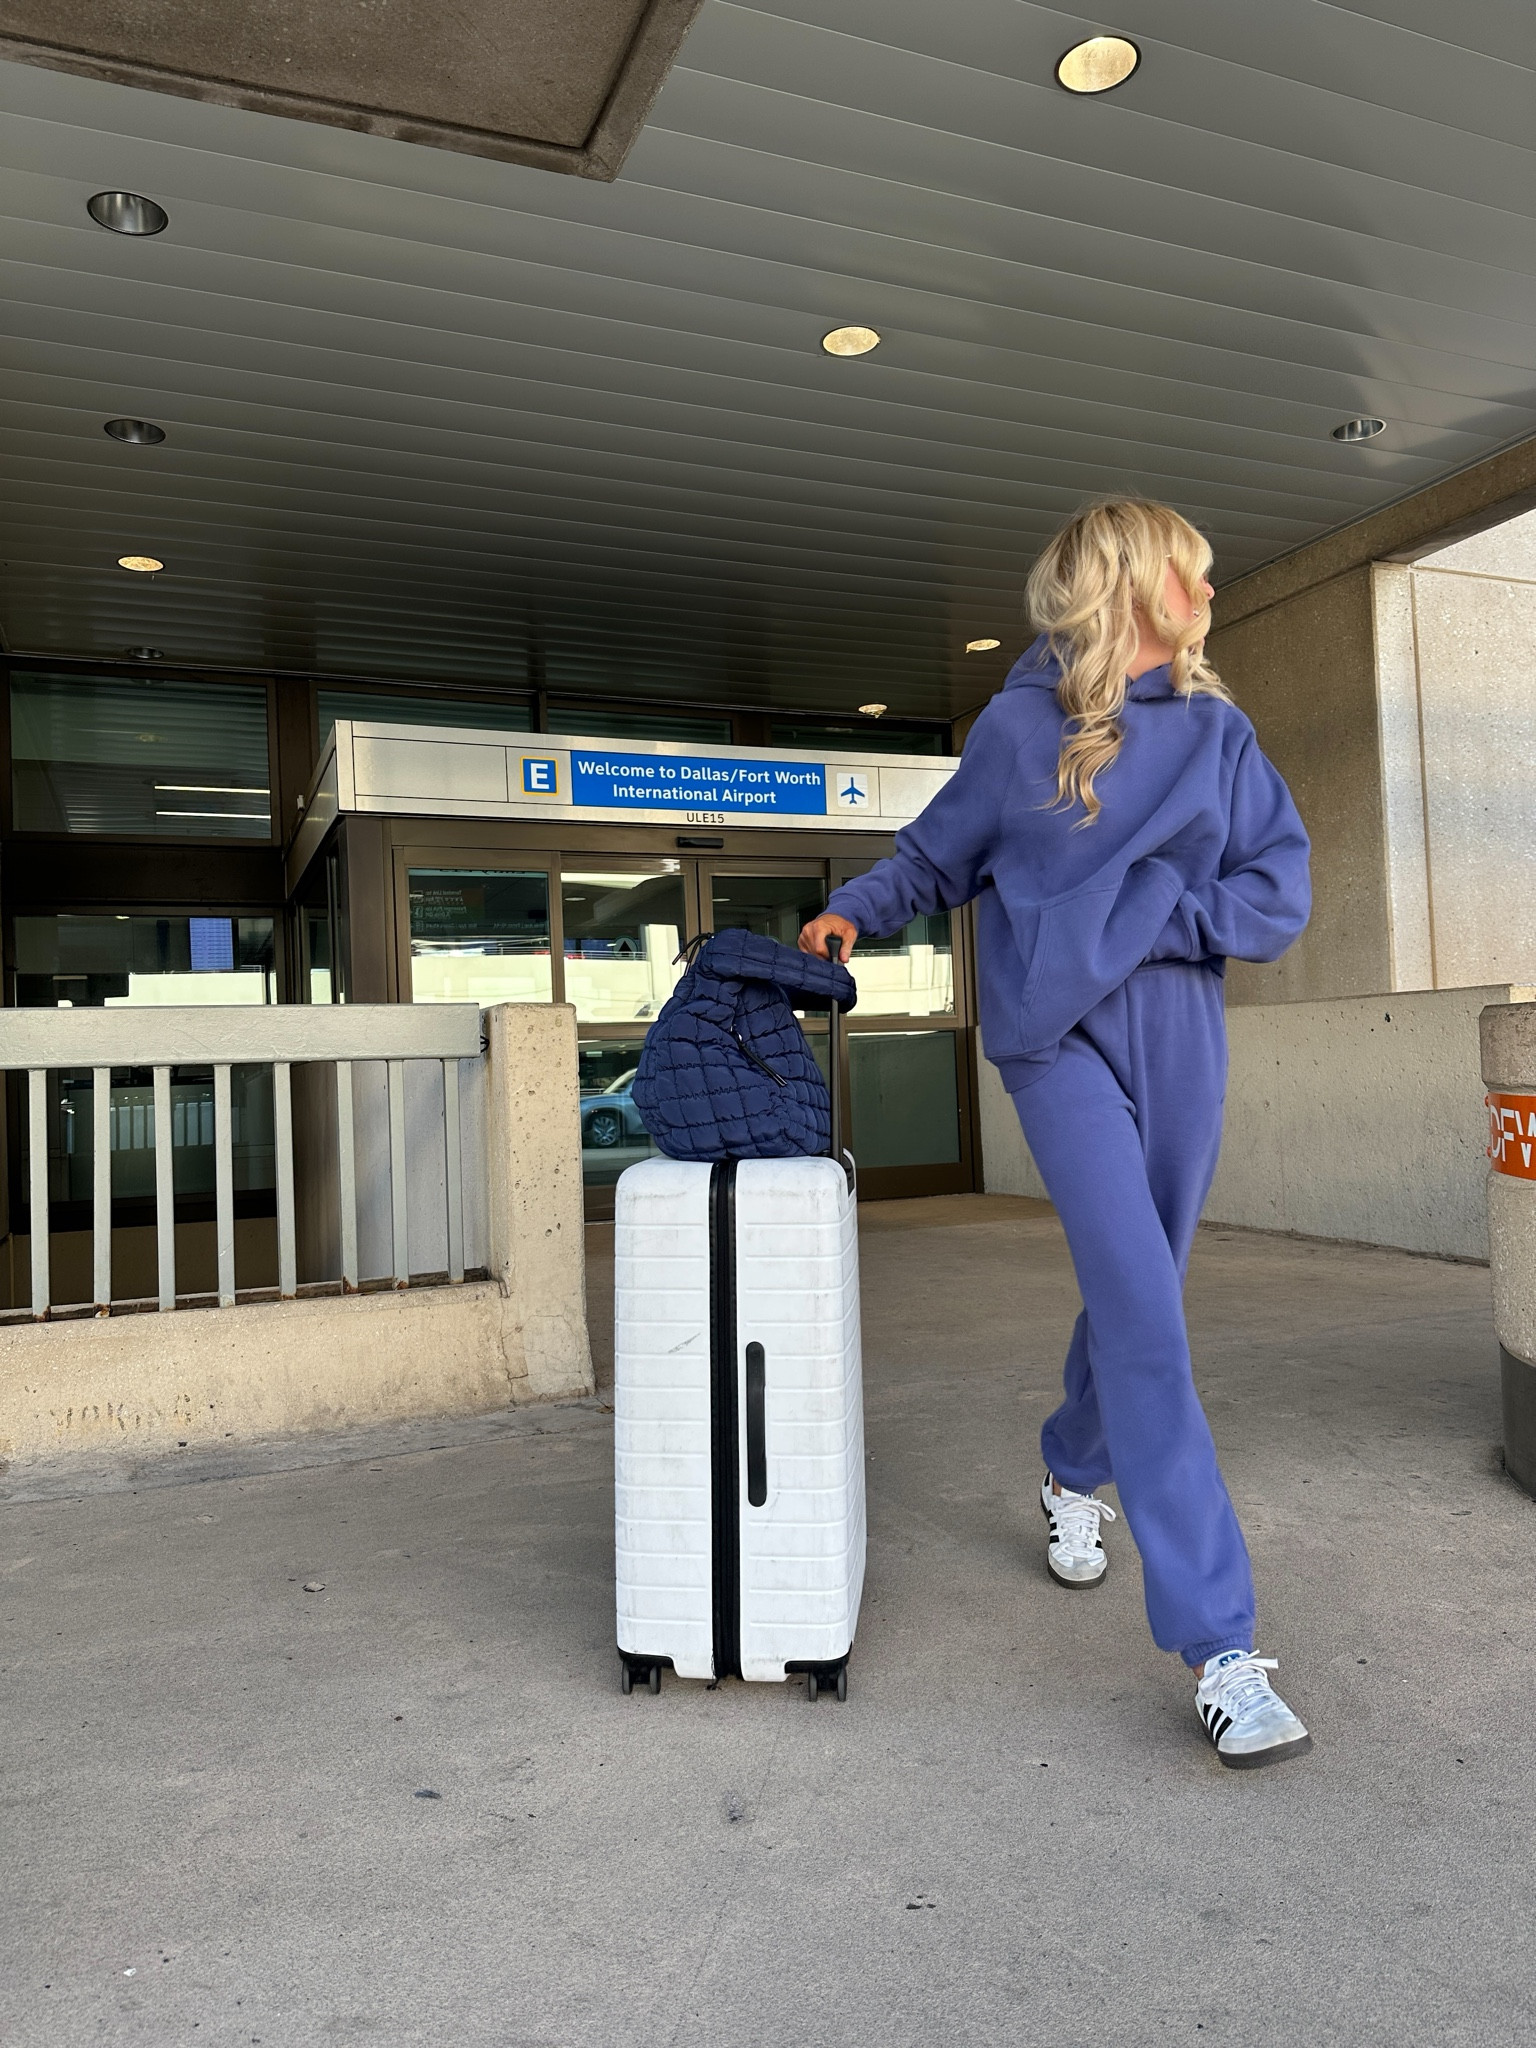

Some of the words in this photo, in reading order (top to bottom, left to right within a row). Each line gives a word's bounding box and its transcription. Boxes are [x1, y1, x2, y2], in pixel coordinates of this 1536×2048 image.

[530, 762, 550, 790] E
[577, 760, 655, 778] Welcome
[658, 765, 676, 779] to
[680, 766, 770, 784] Dallas/Fort
[774, 771, 821, 785] Worth
[613, 784, 718, 802] International
[721, 789, 777, 807] Airport
[686, 812, 725, 824] ULE15
